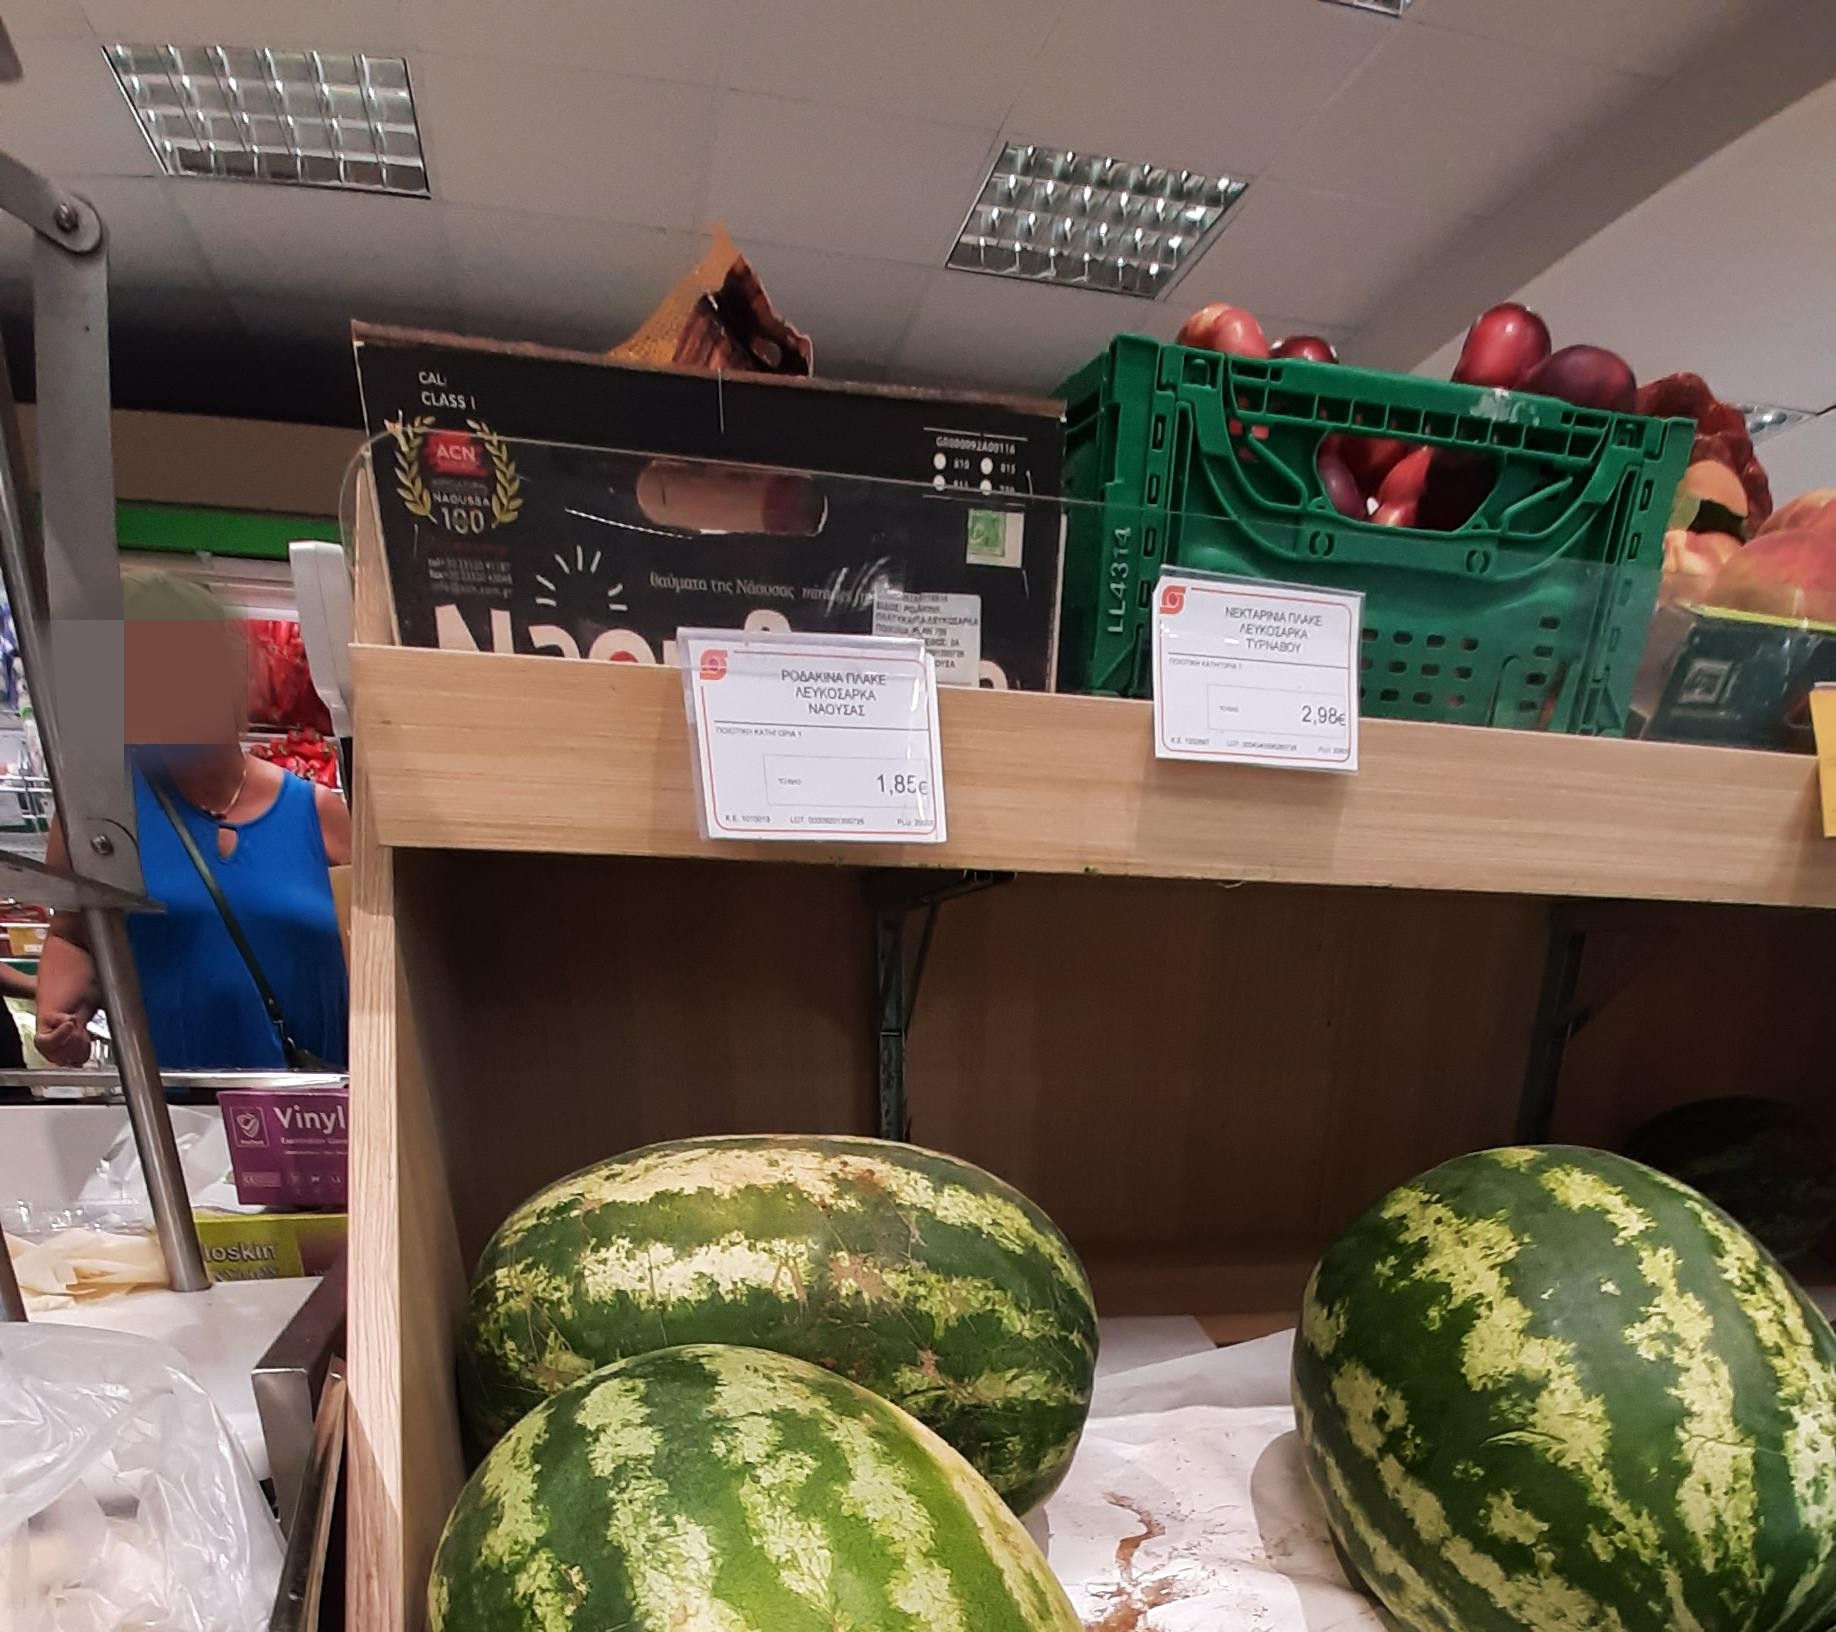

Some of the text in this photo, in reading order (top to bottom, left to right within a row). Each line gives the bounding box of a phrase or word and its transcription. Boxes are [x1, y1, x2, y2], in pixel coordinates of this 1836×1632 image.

[421, 391, 466, 409] CLASS
[436, 445, 476, 462] ACN
[440, 506, 485, 534] 100
[711, 578, 733, 594] της
[735, 578, 795, 599] Νάουσας
[1107, 527, 1131, 633] LL4314
[1225, 607, 1323, 627] ΝΕΚΤΑΡΙΝΙΑ ΠΛΑΚΕ
[1239, 623, 1309, 640] ΛΕΥΚΟΣΑΡΚΑ
[1246, 638, 1302, 653] ΤΥΡΝΑΒΟΥ
[781, 669, 886, 685] ΡΟΔΑΚΙΝΑ ΠΛΑΚΕ
[795, 686, 876, 701] ΛΕΥΚΟΣΑΡΚΑ
[808, 703, 866, 716] ΝΑΟΥΣΑΣ
[1301, 705, 1346, 726] 2,98€
[877, 774, 928, 796] 1,85€
[273, 1104, 347, 1135] Vinyl
